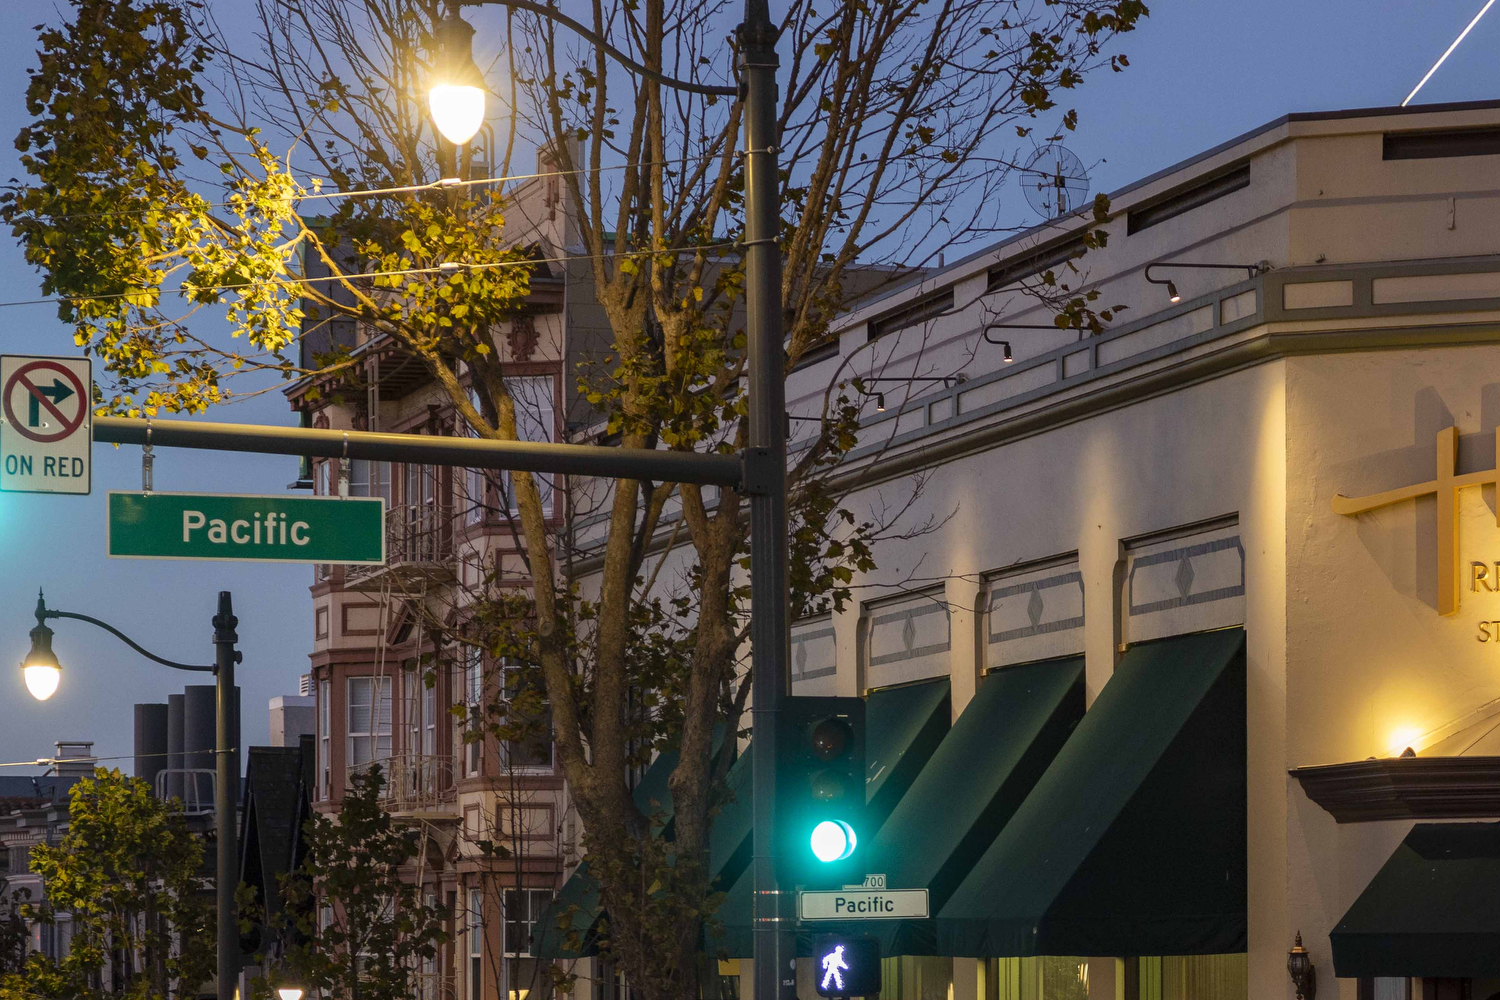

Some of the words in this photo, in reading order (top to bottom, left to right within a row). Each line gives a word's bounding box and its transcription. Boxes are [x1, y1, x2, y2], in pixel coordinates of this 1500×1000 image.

[6, 454, 33, 475] ON
[44, 456, 84, 477] RED
[183, 510, 310, 546] Pacific
[861, 877, 884, 887] 700
[835, 896, 894, 913] Pacific
